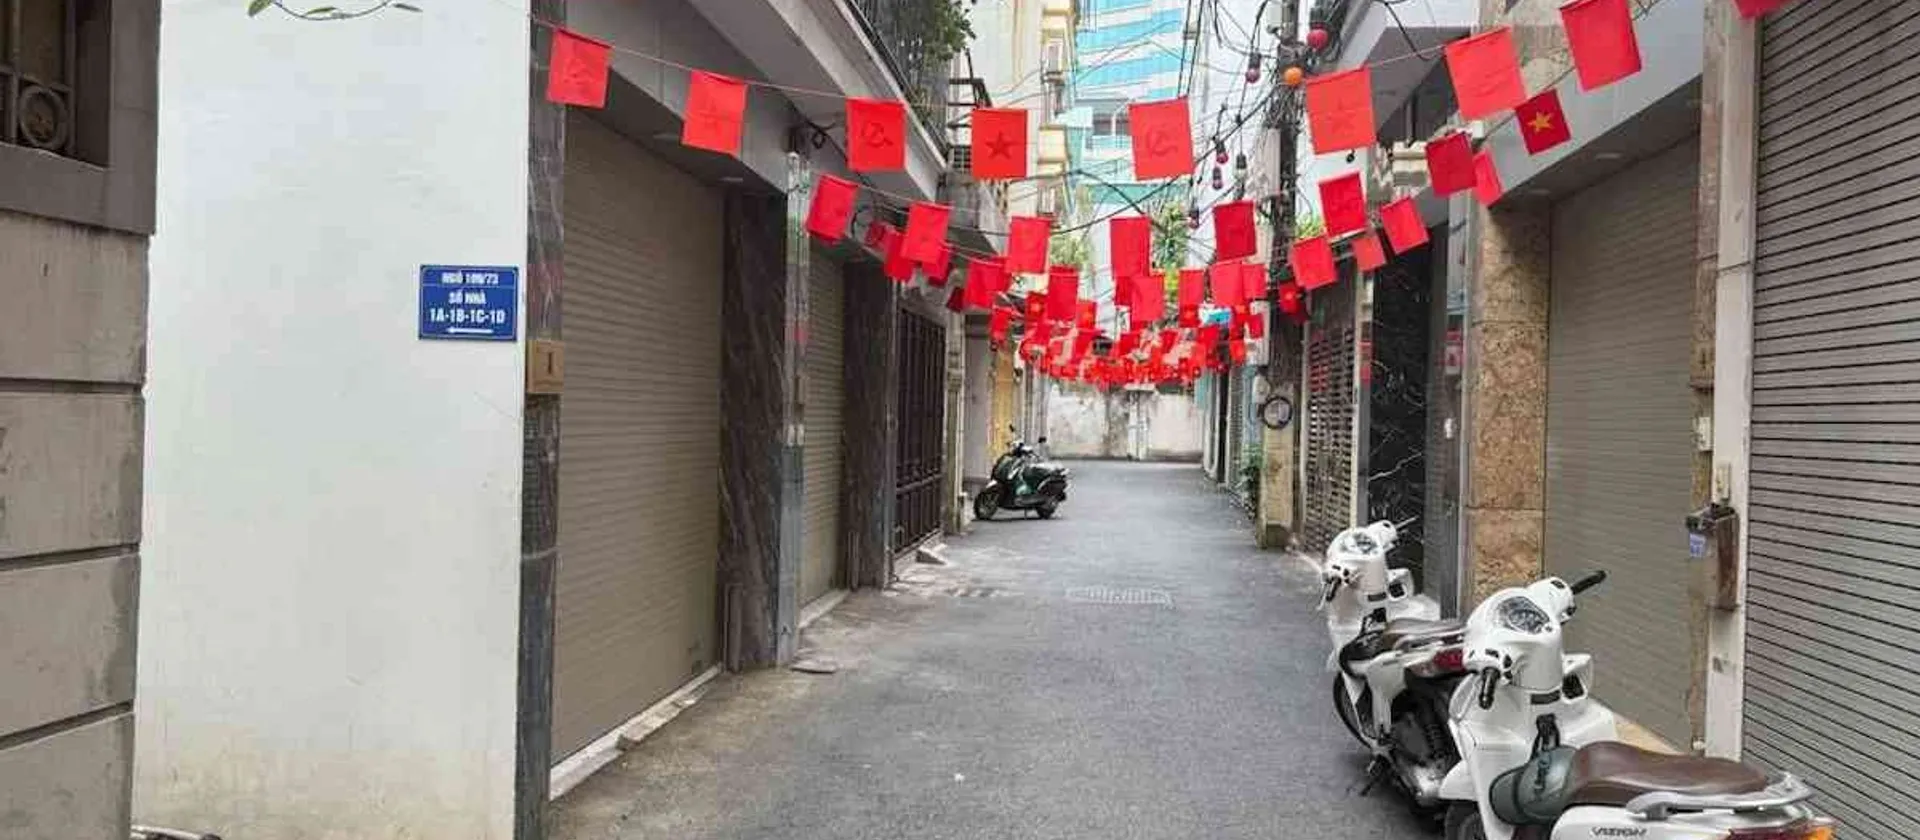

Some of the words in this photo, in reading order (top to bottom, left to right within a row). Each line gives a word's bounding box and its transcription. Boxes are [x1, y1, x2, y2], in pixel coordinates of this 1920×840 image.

[448, 289, 463, 304] SỐ
[464, 289, 486, 304] NHÀ
[430, 308, 506, 324] 1A-1B-1C-1D
